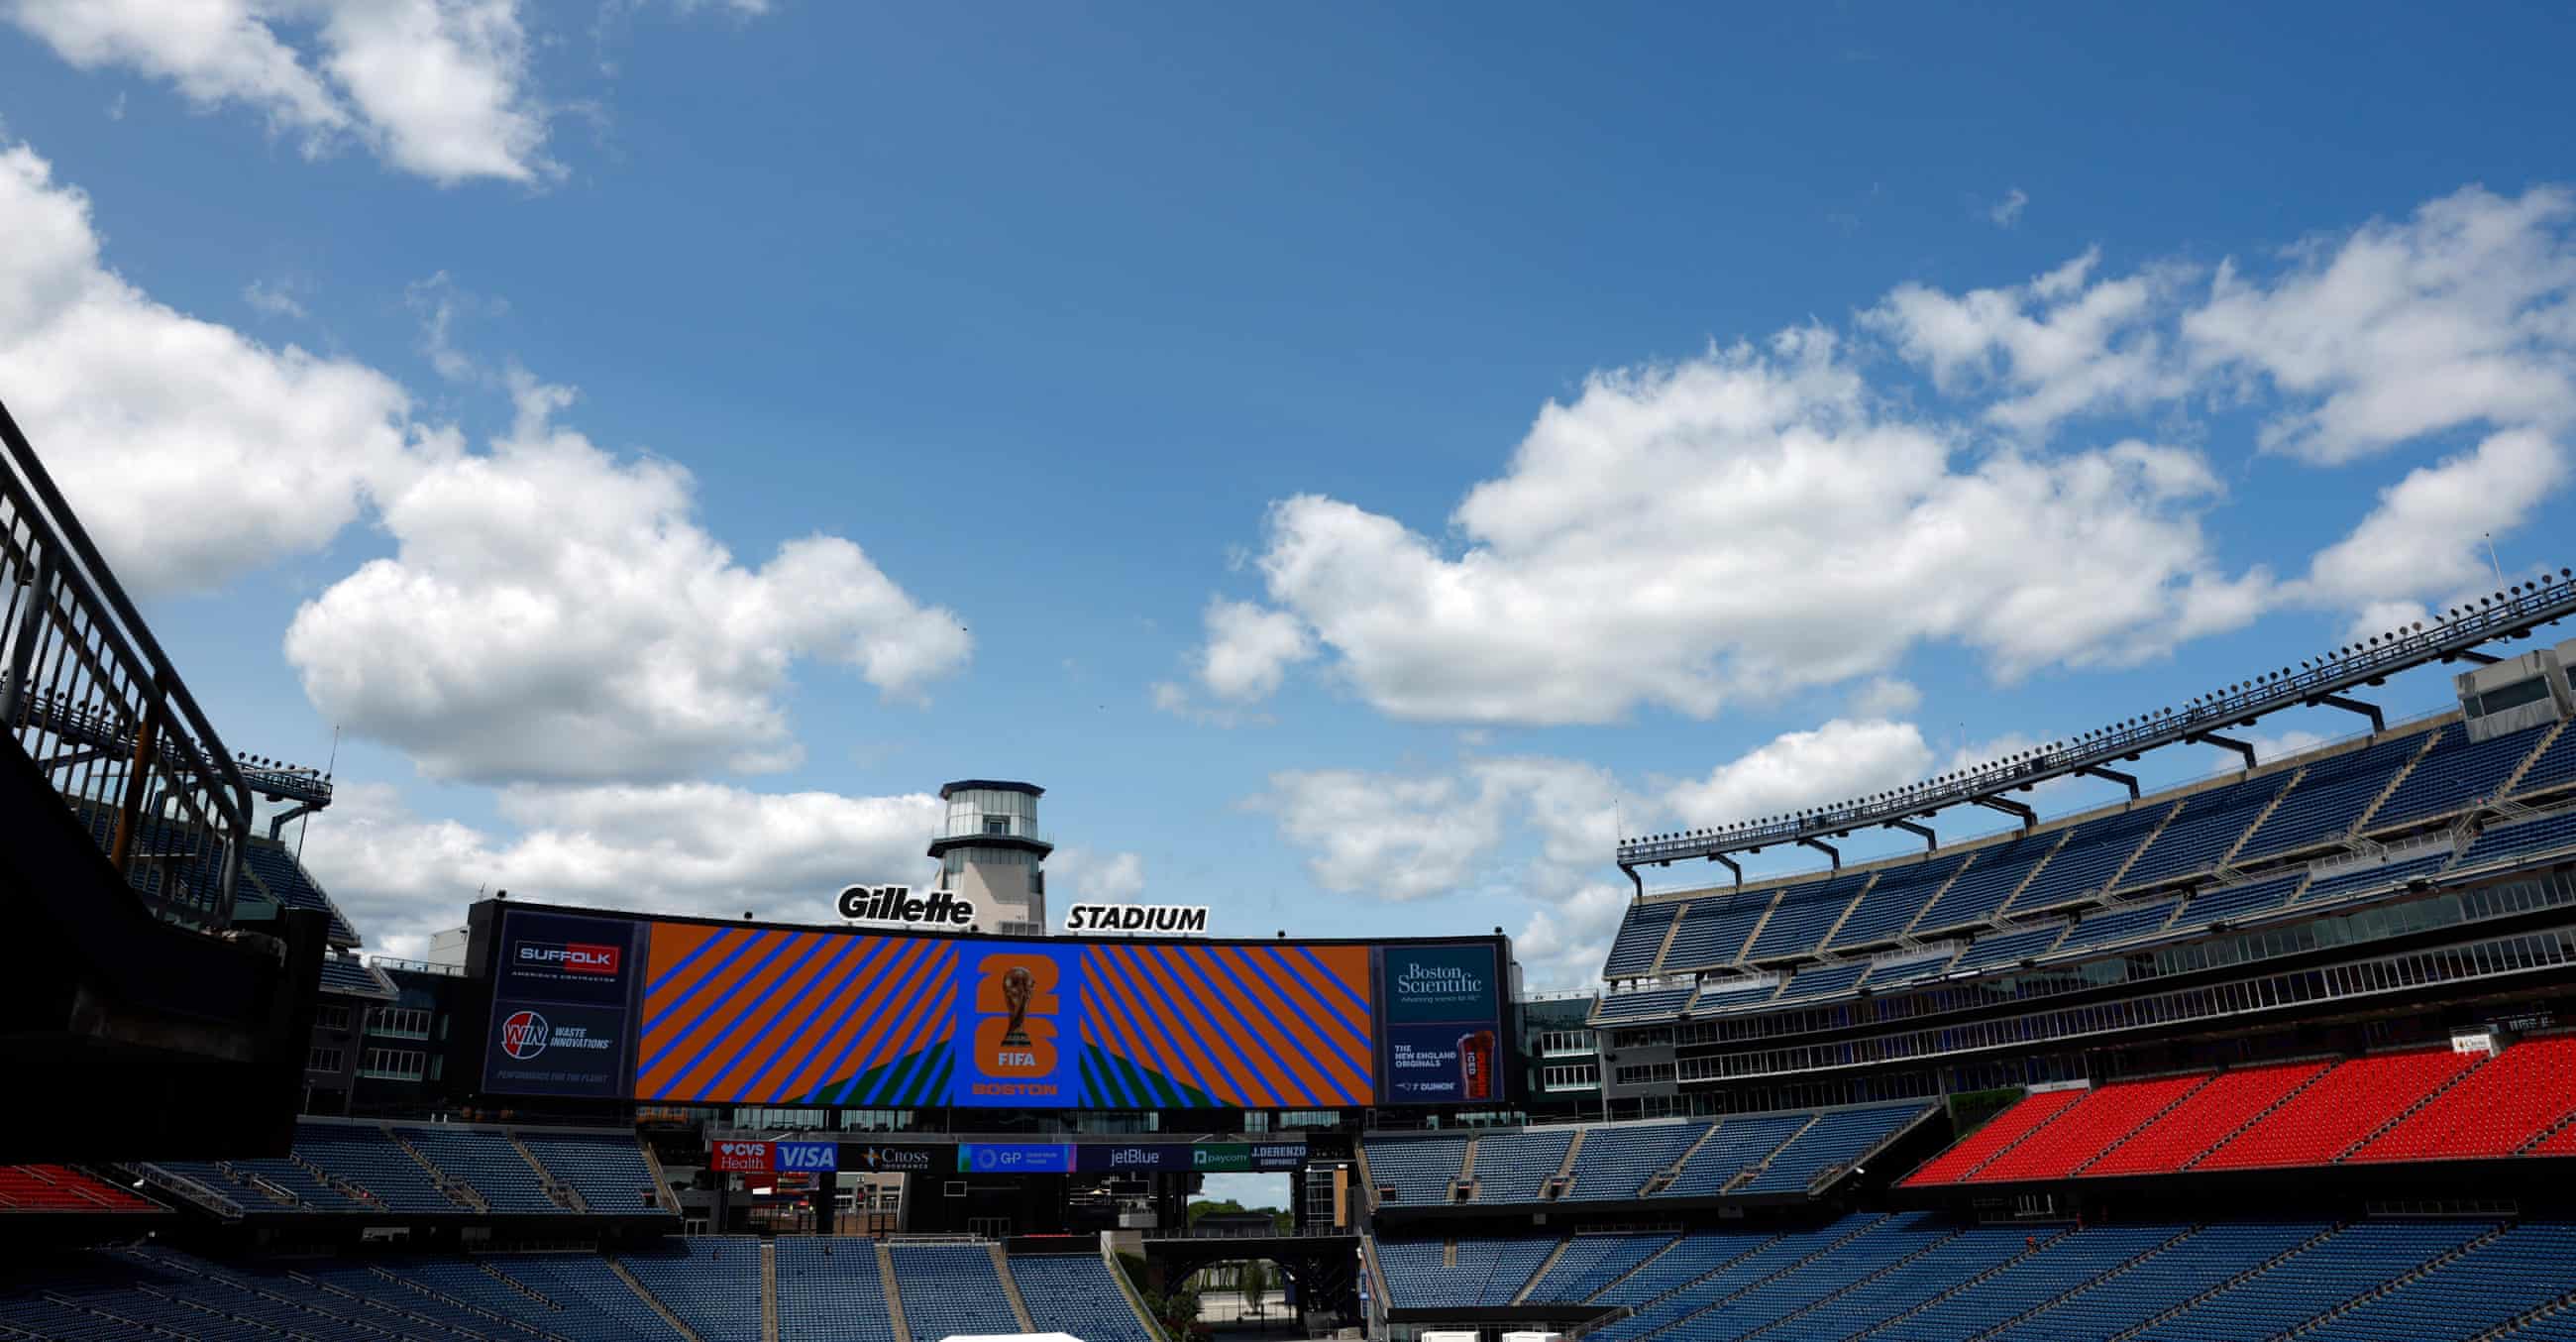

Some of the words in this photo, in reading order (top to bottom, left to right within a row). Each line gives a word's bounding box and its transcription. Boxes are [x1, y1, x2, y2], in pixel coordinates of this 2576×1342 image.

[837, 886, 974, 925] Gillette
[1067, 904, 1208, 932] STADIUM
[520, 947, 610, 965] SUFFOLK
[1409, 962, 1461, 979] Boston
[1398, 973, 1483, 993] Scientific
[506, 1023, 546, 1046] WIN
[555, 1027, 588, 1038] WASTE
[998, 1053, 1036, 1066] FIFA
[1416, 1052, 1456, 1061] ENGLAND
[972, 1083, 1059, 1095] BOSTON
[735, 1143, 766, 1156] CVS
[778, 1146, 835, 1168] VISA
[720, 1157, 765, 1170] Health
[1110, 1148, 1160, 1167] jetBlue
[1208, 1154, 1247, 1165] paycom
